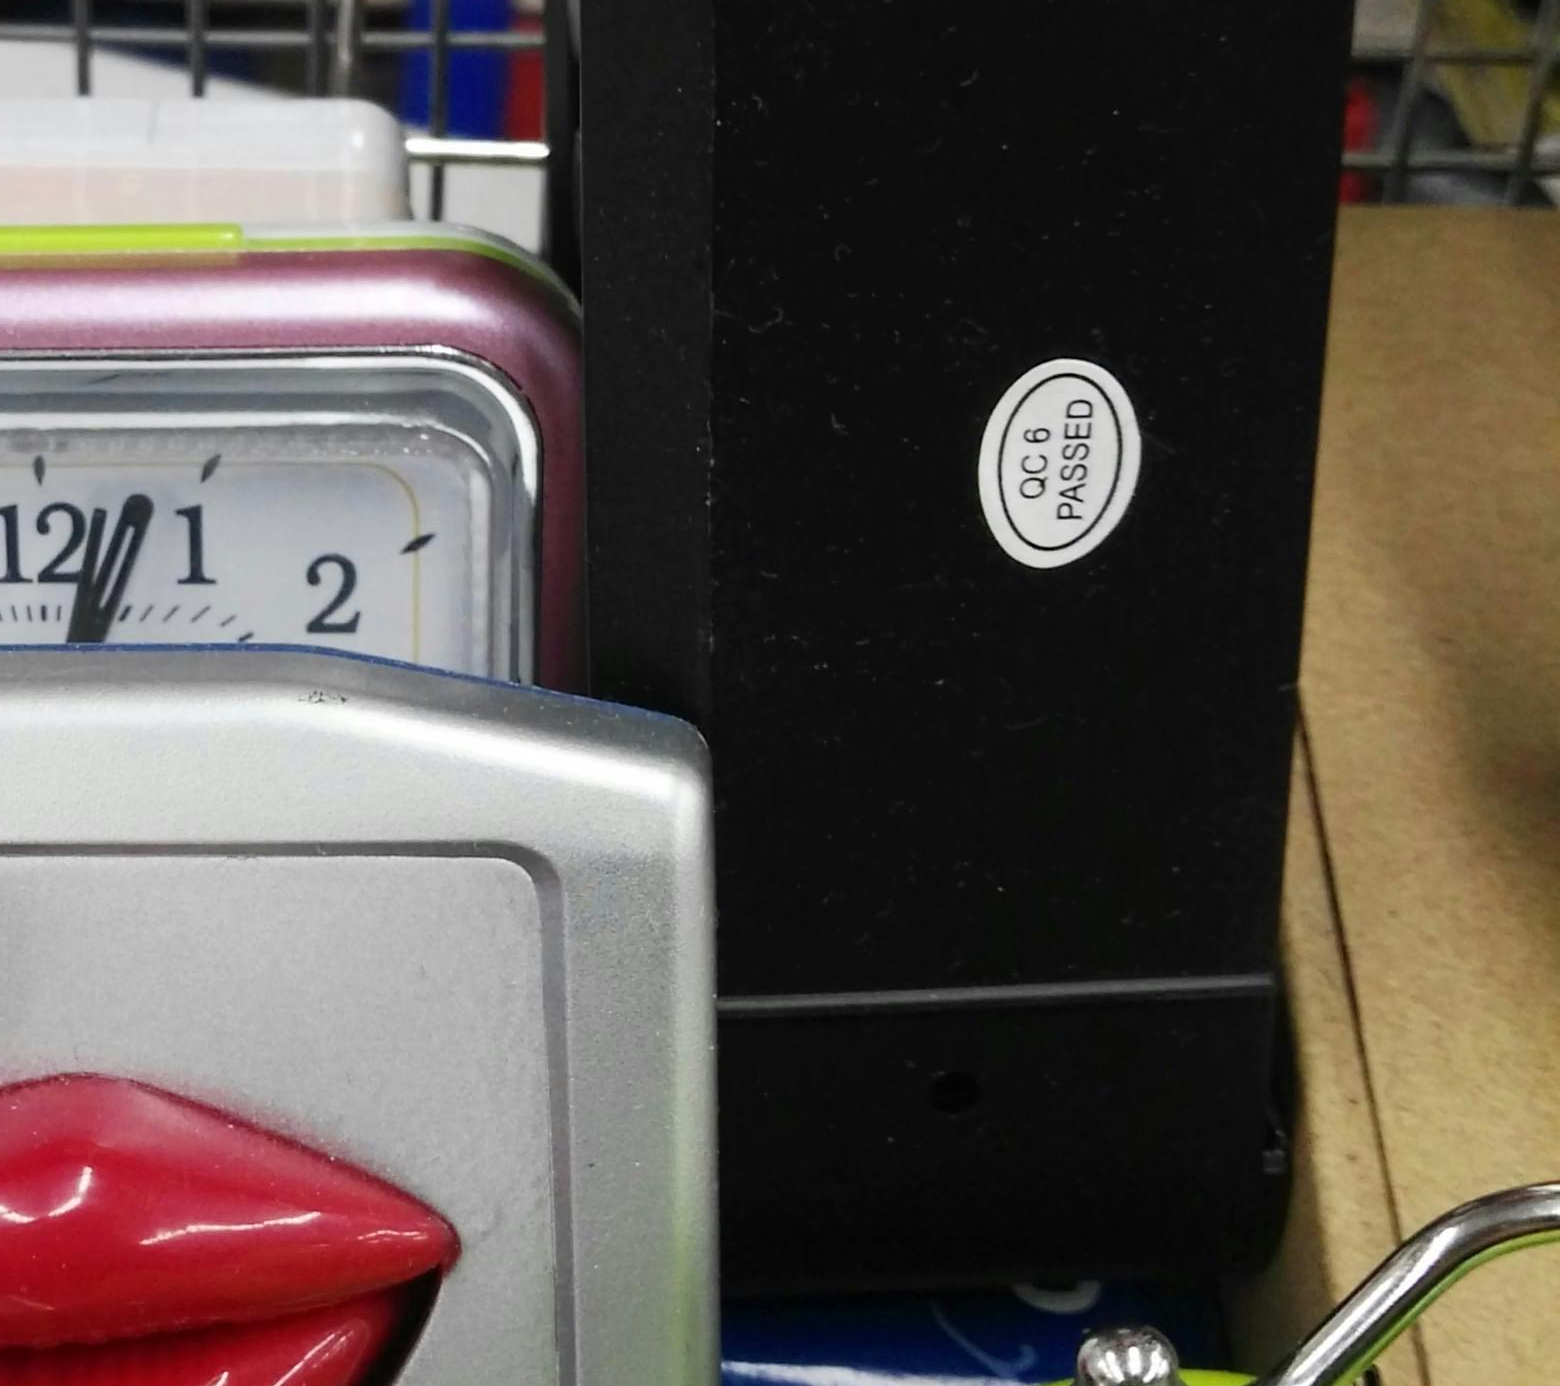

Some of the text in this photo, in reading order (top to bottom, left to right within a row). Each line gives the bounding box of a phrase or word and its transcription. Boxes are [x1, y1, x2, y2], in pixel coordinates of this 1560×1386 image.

[1019, 427, 1051, 499] QC 6
[1056, 399, 1094, 521] PASSED
[175, 504, 217, 586] 1
[304, 553, 361, 634] 2
